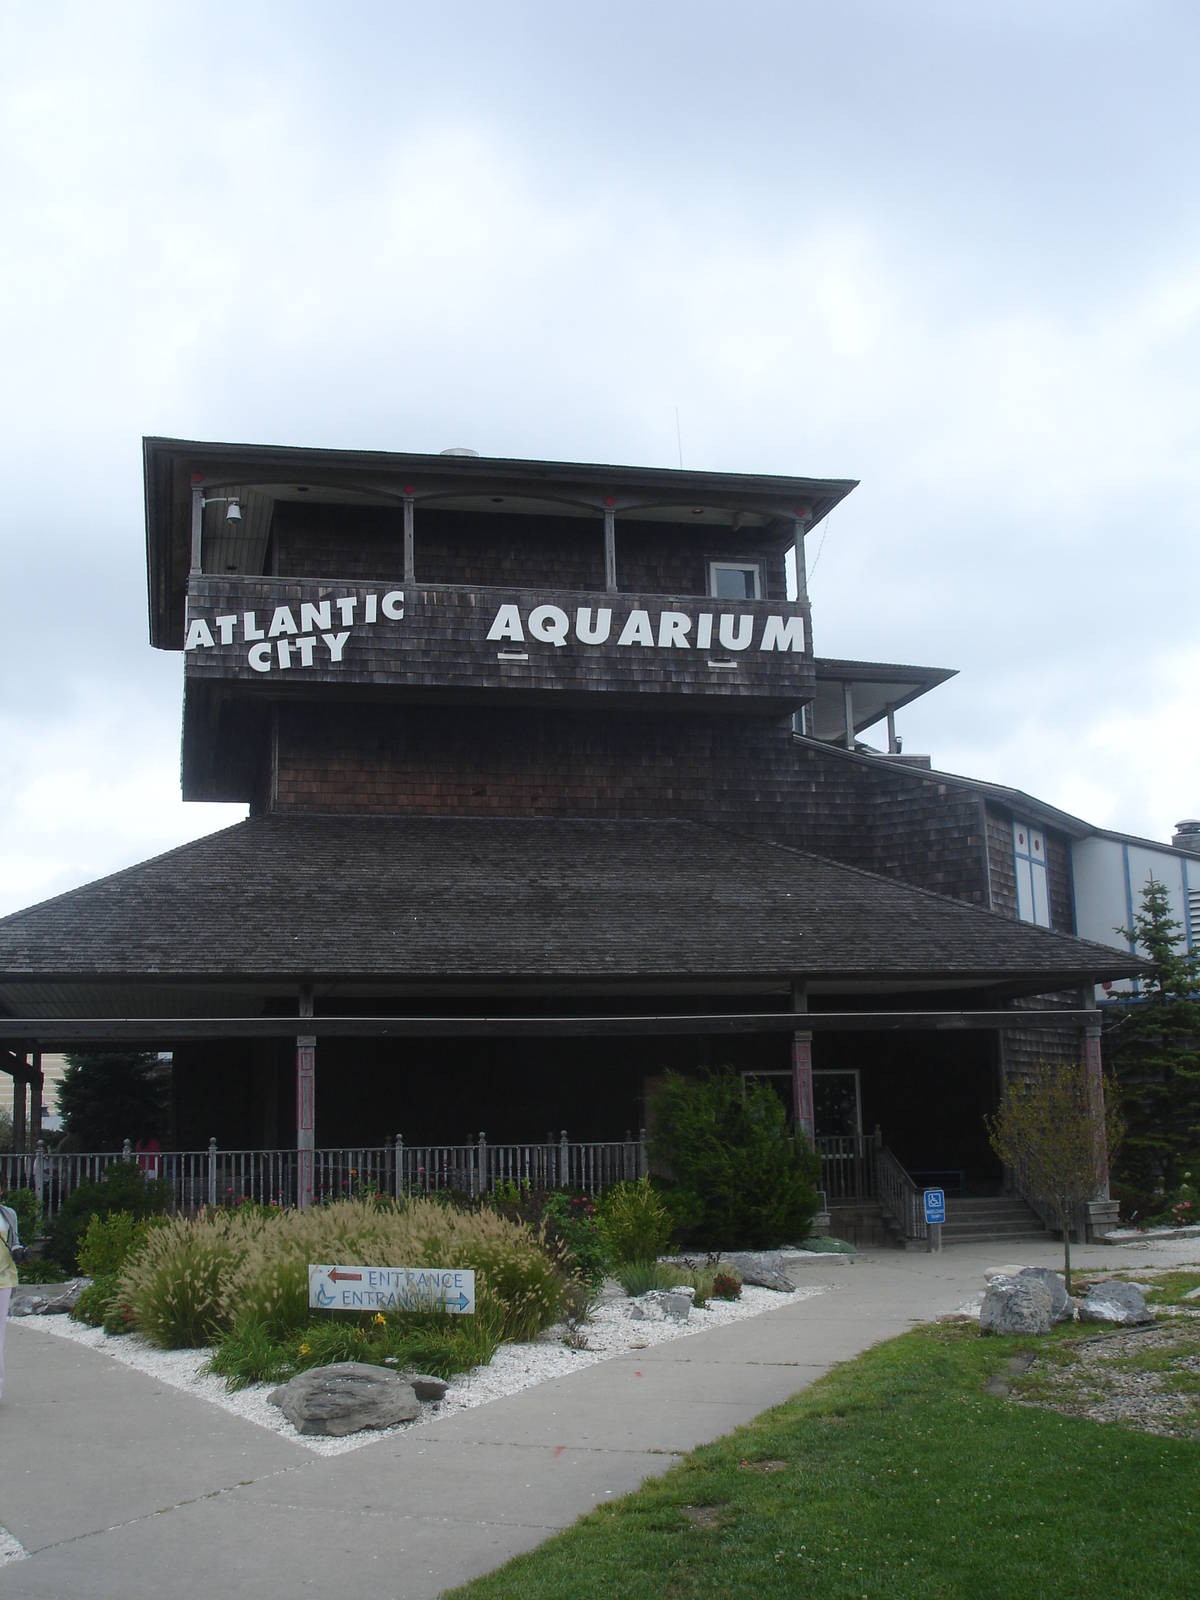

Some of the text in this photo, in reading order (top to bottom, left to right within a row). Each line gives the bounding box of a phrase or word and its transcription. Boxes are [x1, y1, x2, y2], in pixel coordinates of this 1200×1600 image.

[184, 590, 405, 650] ATLANTIC
[486, 604, 806, 653] AQUARIUM
[247, 631, 351, 673] CITY
[368, 1270, 465, 1289] ENTRANCE
